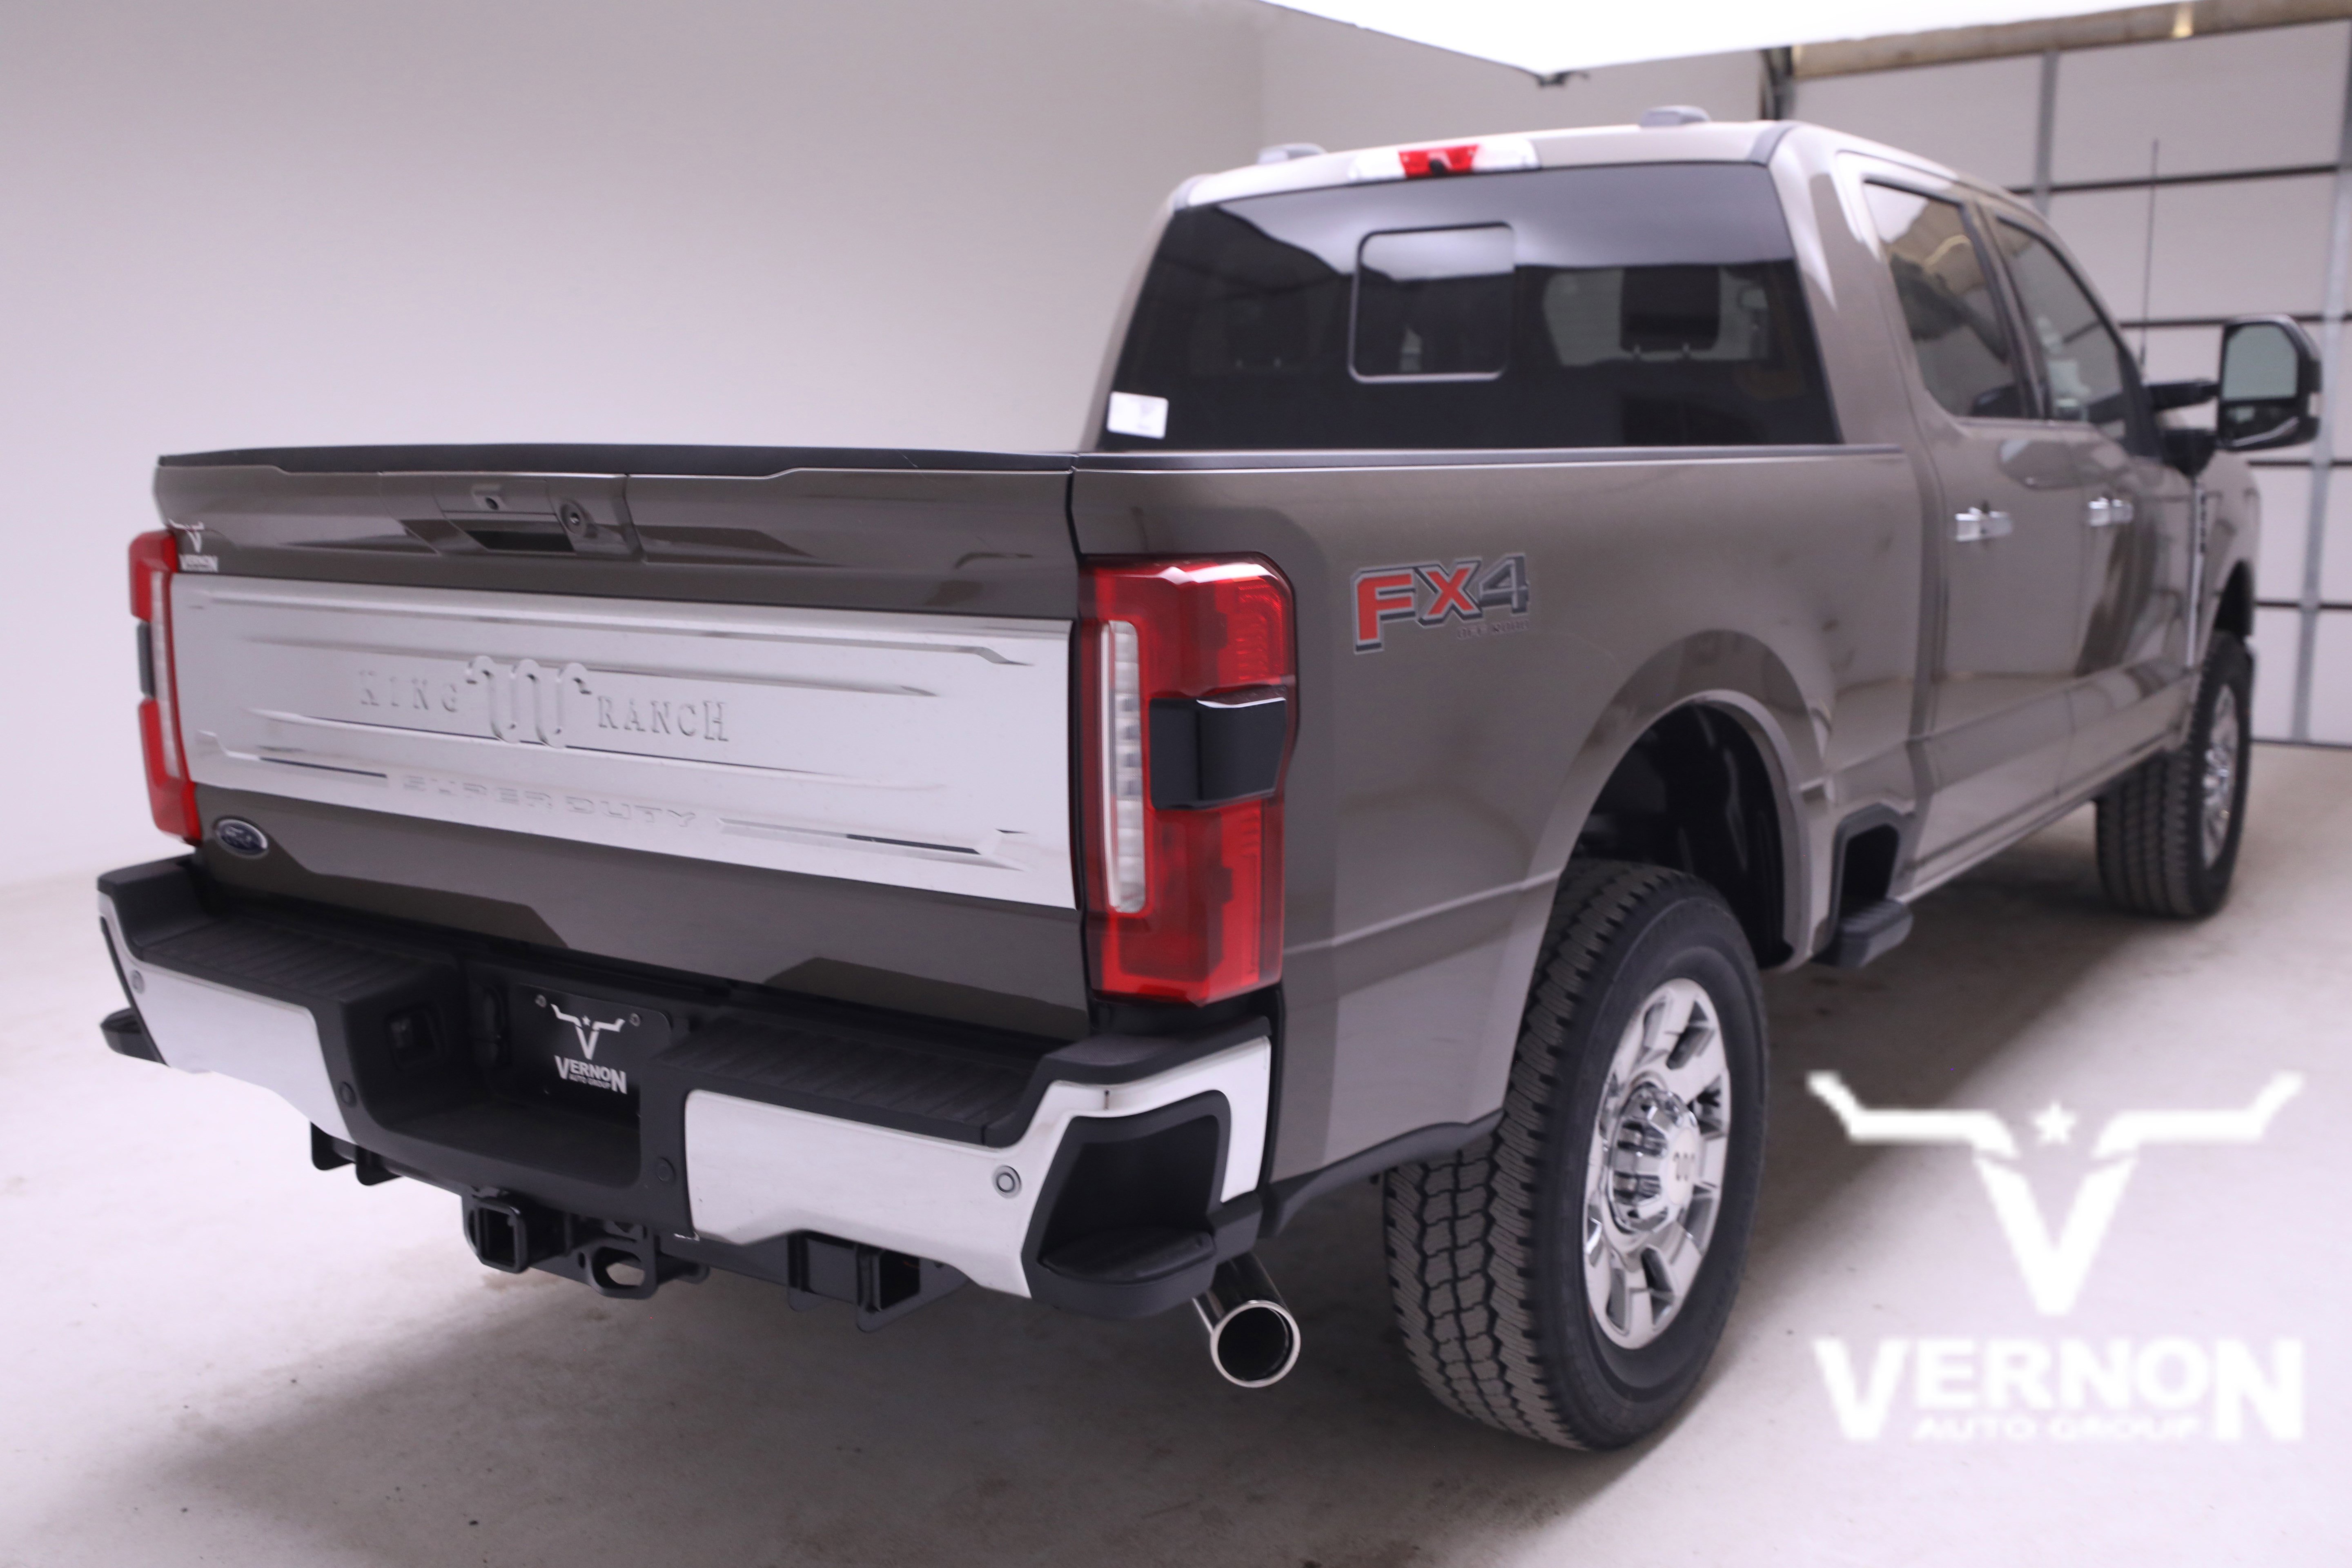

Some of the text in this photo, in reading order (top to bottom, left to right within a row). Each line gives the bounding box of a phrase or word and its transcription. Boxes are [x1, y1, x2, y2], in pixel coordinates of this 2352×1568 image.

[1351, 552, 1530, 655] FX4
[359, 669, 729, 742] KING RANCH
[564, 795, 696, 828] DUTY
[554, 1054, 628, 1095] VERNON
